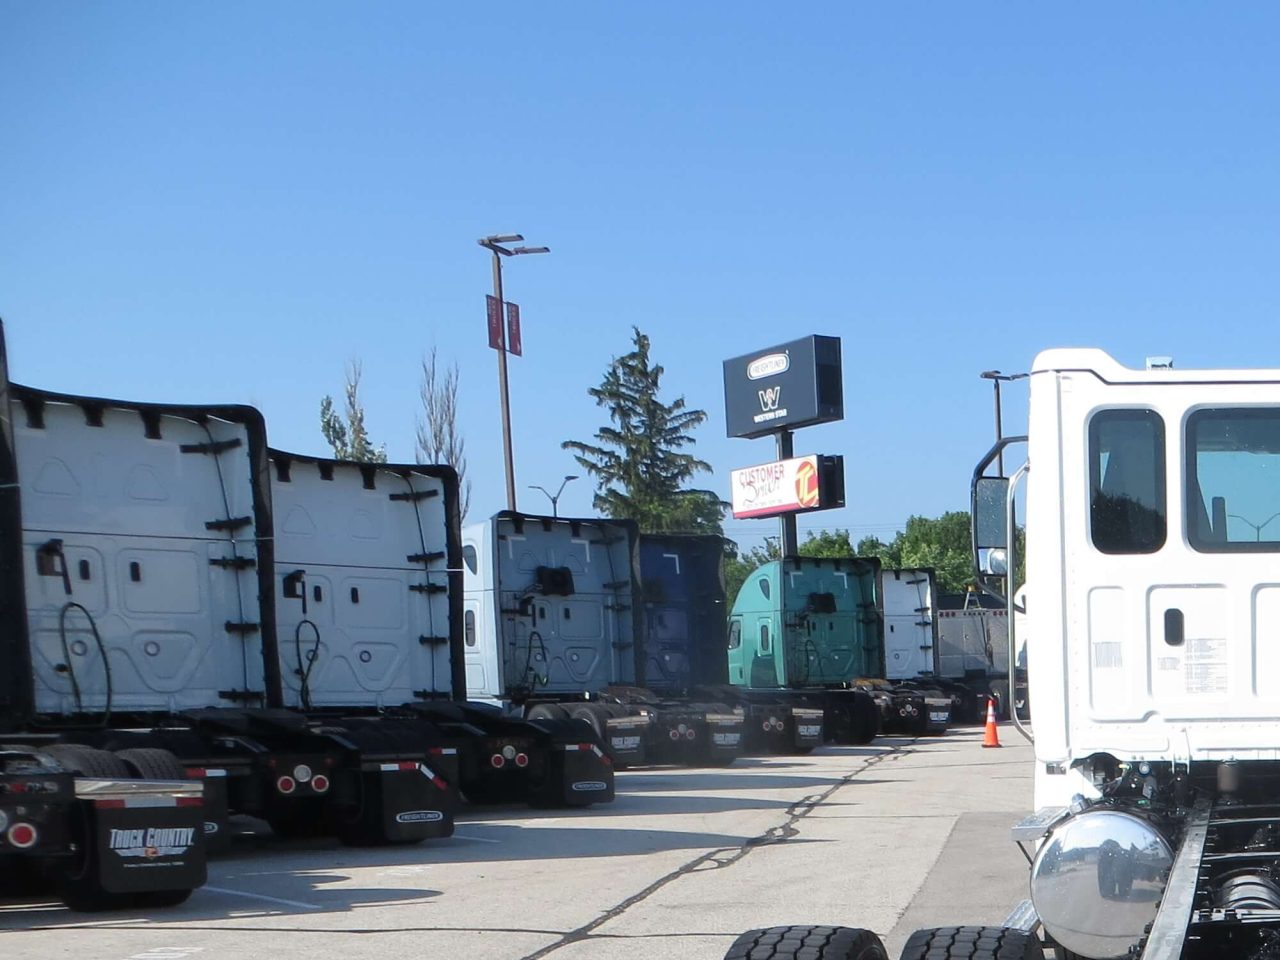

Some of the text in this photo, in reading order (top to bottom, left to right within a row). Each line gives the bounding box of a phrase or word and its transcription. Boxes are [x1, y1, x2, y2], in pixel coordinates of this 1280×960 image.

[739, 463, 785, 484] CUSTOMER
[110, 827, 195, 849] TRUCK COUNTRY
